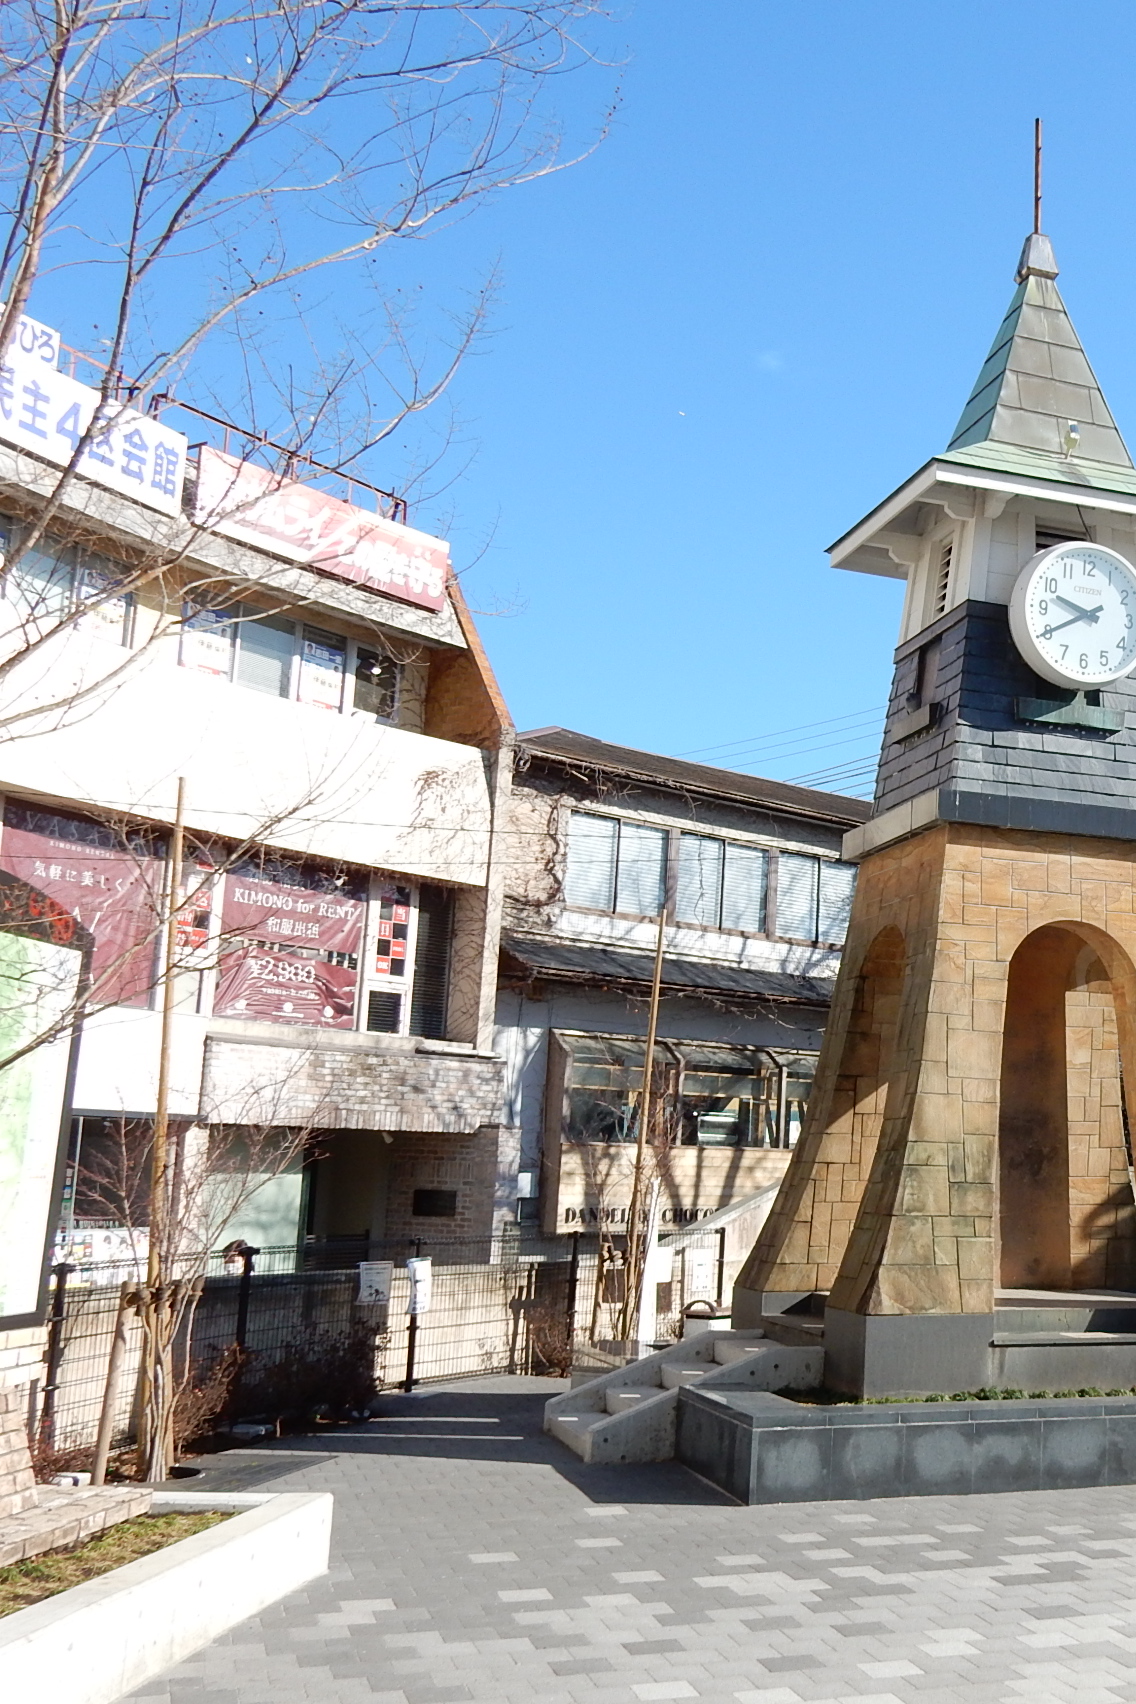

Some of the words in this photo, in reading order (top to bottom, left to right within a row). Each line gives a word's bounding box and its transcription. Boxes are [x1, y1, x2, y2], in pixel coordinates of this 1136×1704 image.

[1062, 562, 1073, 580] 11
[1082, 559, 1096, 577] 12
[1044, 576, 1058, 594] 10
[1073, 585, 1102, 596] CITIZEN
[1120, 589, 1129, 606] 2
[1039, 599, 1048, 615] 9
[1124, 613, 1134, 630] 3
[1043, 624, 1053, 640] 8
[1116, 636, 1127, 651] 4
[1059, 644, 1069, 661] 7
[1079, 653, 1088, 669] 6
[1099, 650, 1109, 667] 5
[33, 860, 124, 892] 気軽に美しく
[233, 888, 293, 911] KIMONO
[297, 899, 315, 914] for
[318, 902, 354, 920] RENT
[266, 916, 320, 938] 和服出租
[564, 1206, 653, 1225] DANDELN
[661, 1207, 721, 1225] CHOCO
